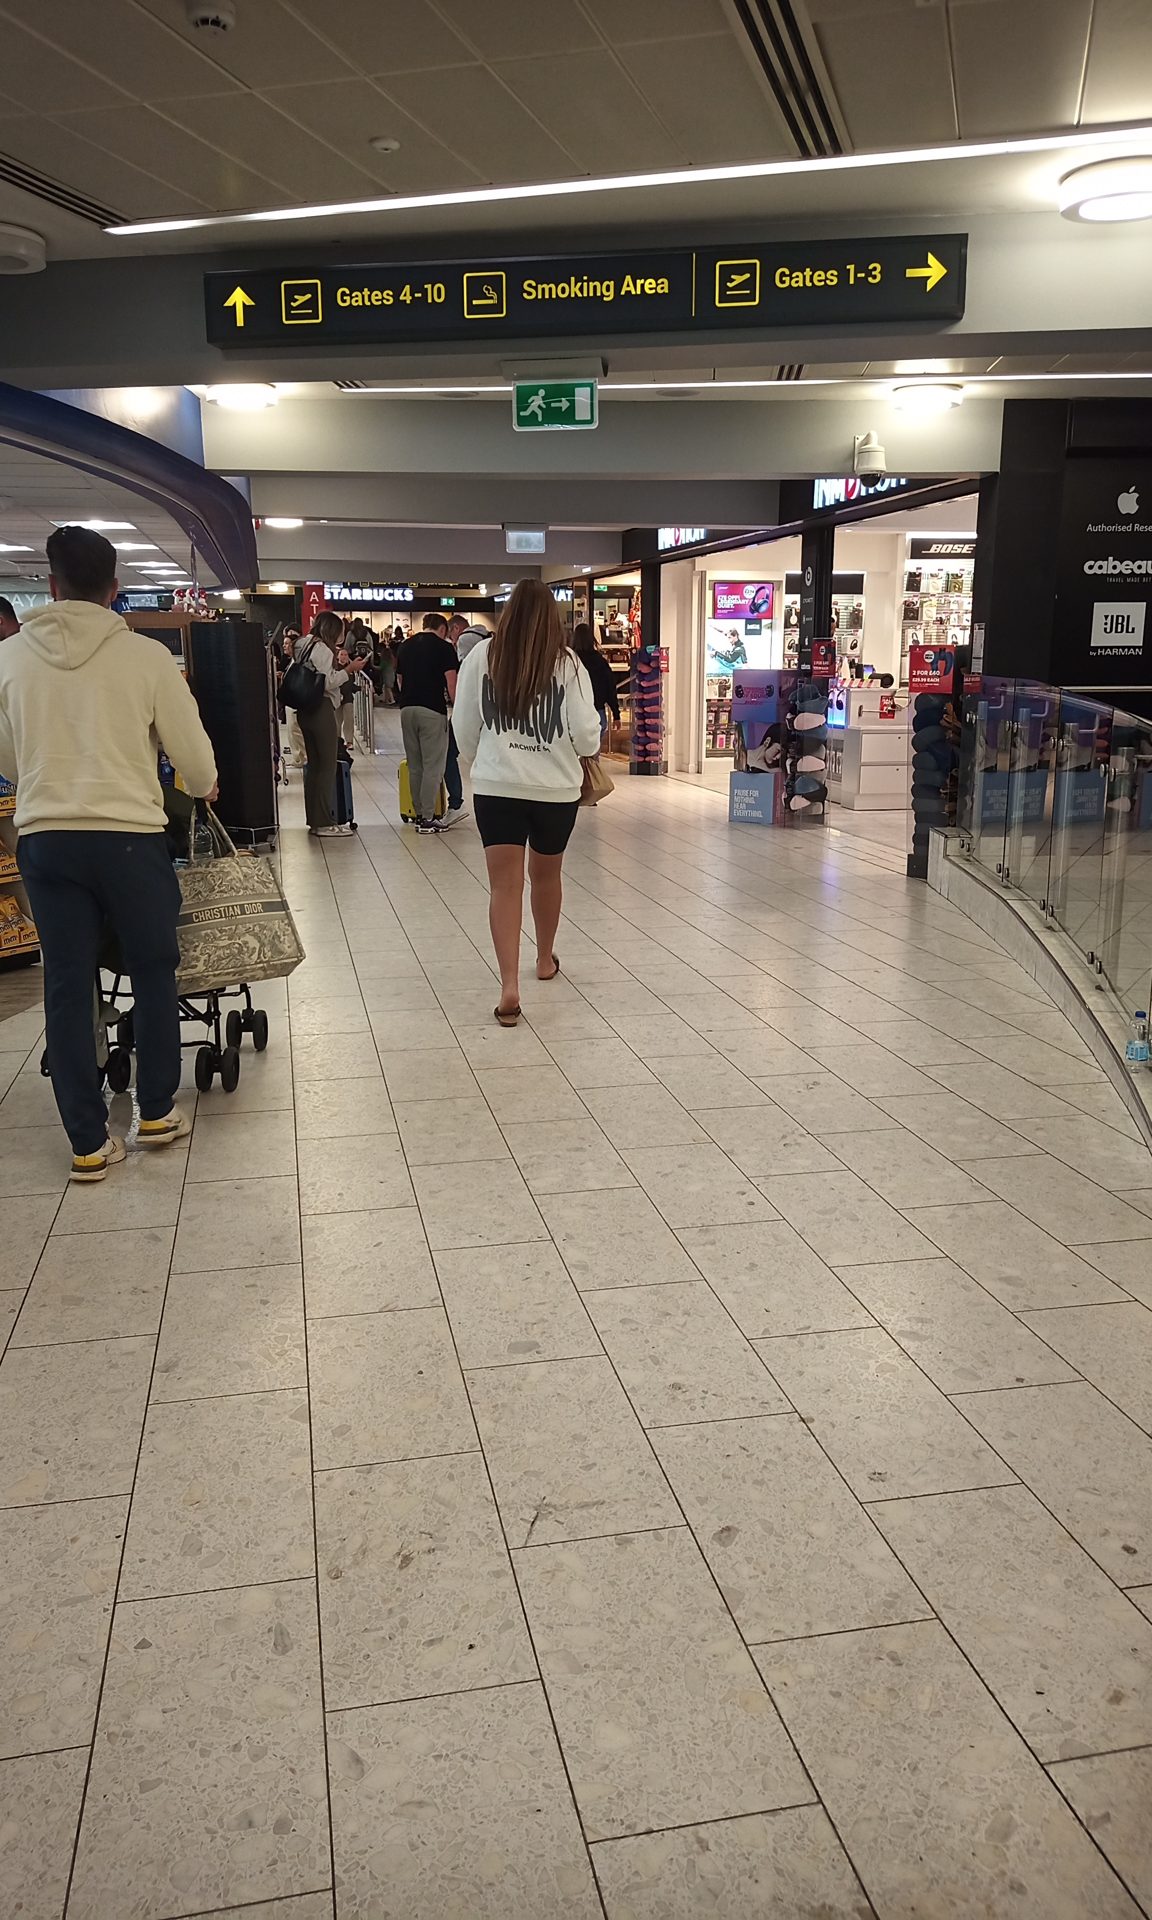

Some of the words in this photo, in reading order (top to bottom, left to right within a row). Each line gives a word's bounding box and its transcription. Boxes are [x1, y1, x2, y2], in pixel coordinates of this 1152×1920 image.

[775, 267, 839, 289] Gates
[846, 262, 882, 285] 1-3
[336, 286, 394, 307] Gates
[399, 283, 446, 304] 4-10
[522, 276, 615, 302] Smoking
[620, 274, 670, 296] Area
[1086, 523, 1133, 532] Authorised
[921, 543, 976, 554] BOSE
[324, 588, 414, 601] STARBUCKS
[1104, 614, 1136, 634] JBL
[1097, 648, 1143, 656] HARMAN
[192, 905, 241, 923] CHRISTIAN
[244, 903, 264, 914] DIOR
